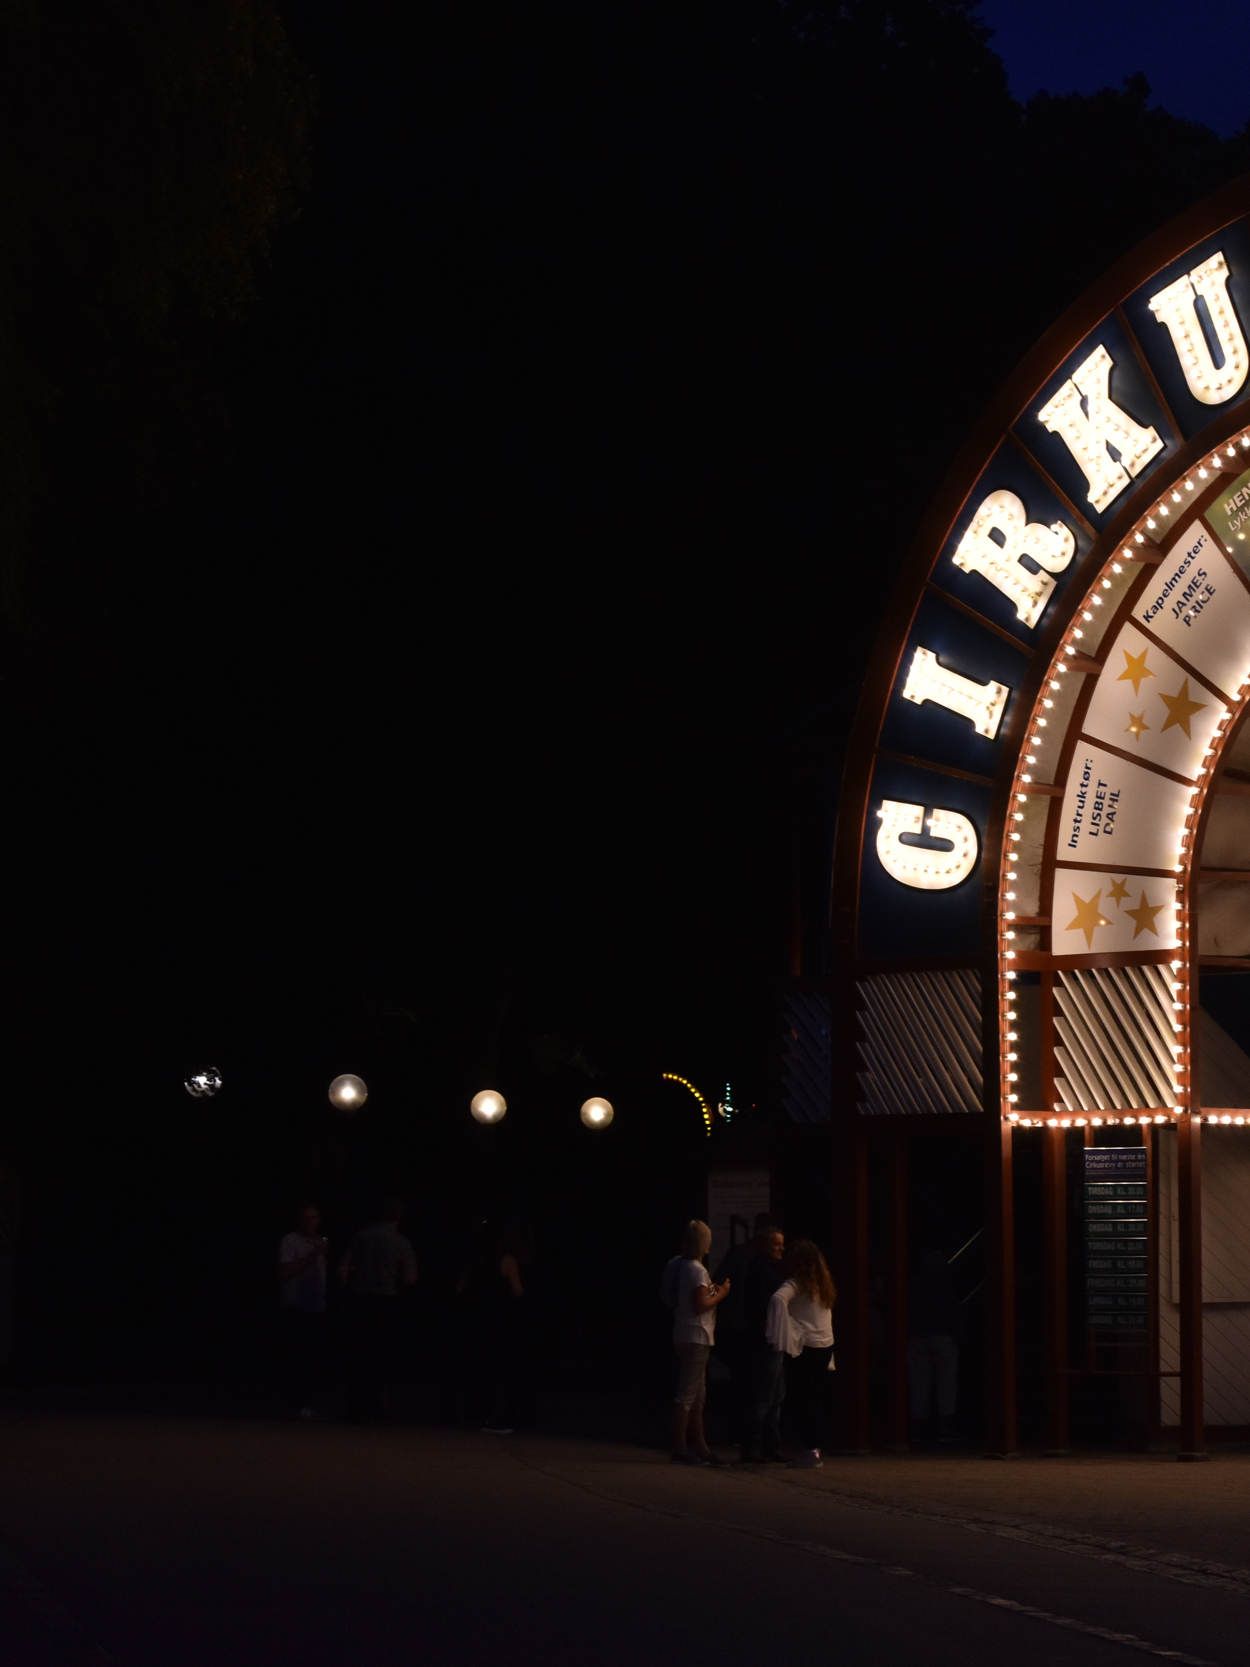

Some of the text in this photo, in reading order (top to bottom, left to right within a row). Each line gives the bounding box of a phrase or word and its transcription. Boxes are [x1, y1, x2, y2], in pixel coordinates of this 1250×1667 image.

[1142, 534, 1209, 624] Kapelmester:
[1172, 568, 1208, 620] JAMES
[1183, 583, 1217, 628] PRICE
[1068, 758, 1094, 848] Instruktør:
[1089, 780, 1109, 837] LISBET
[1103, 788, 1120, 836] DAHL
